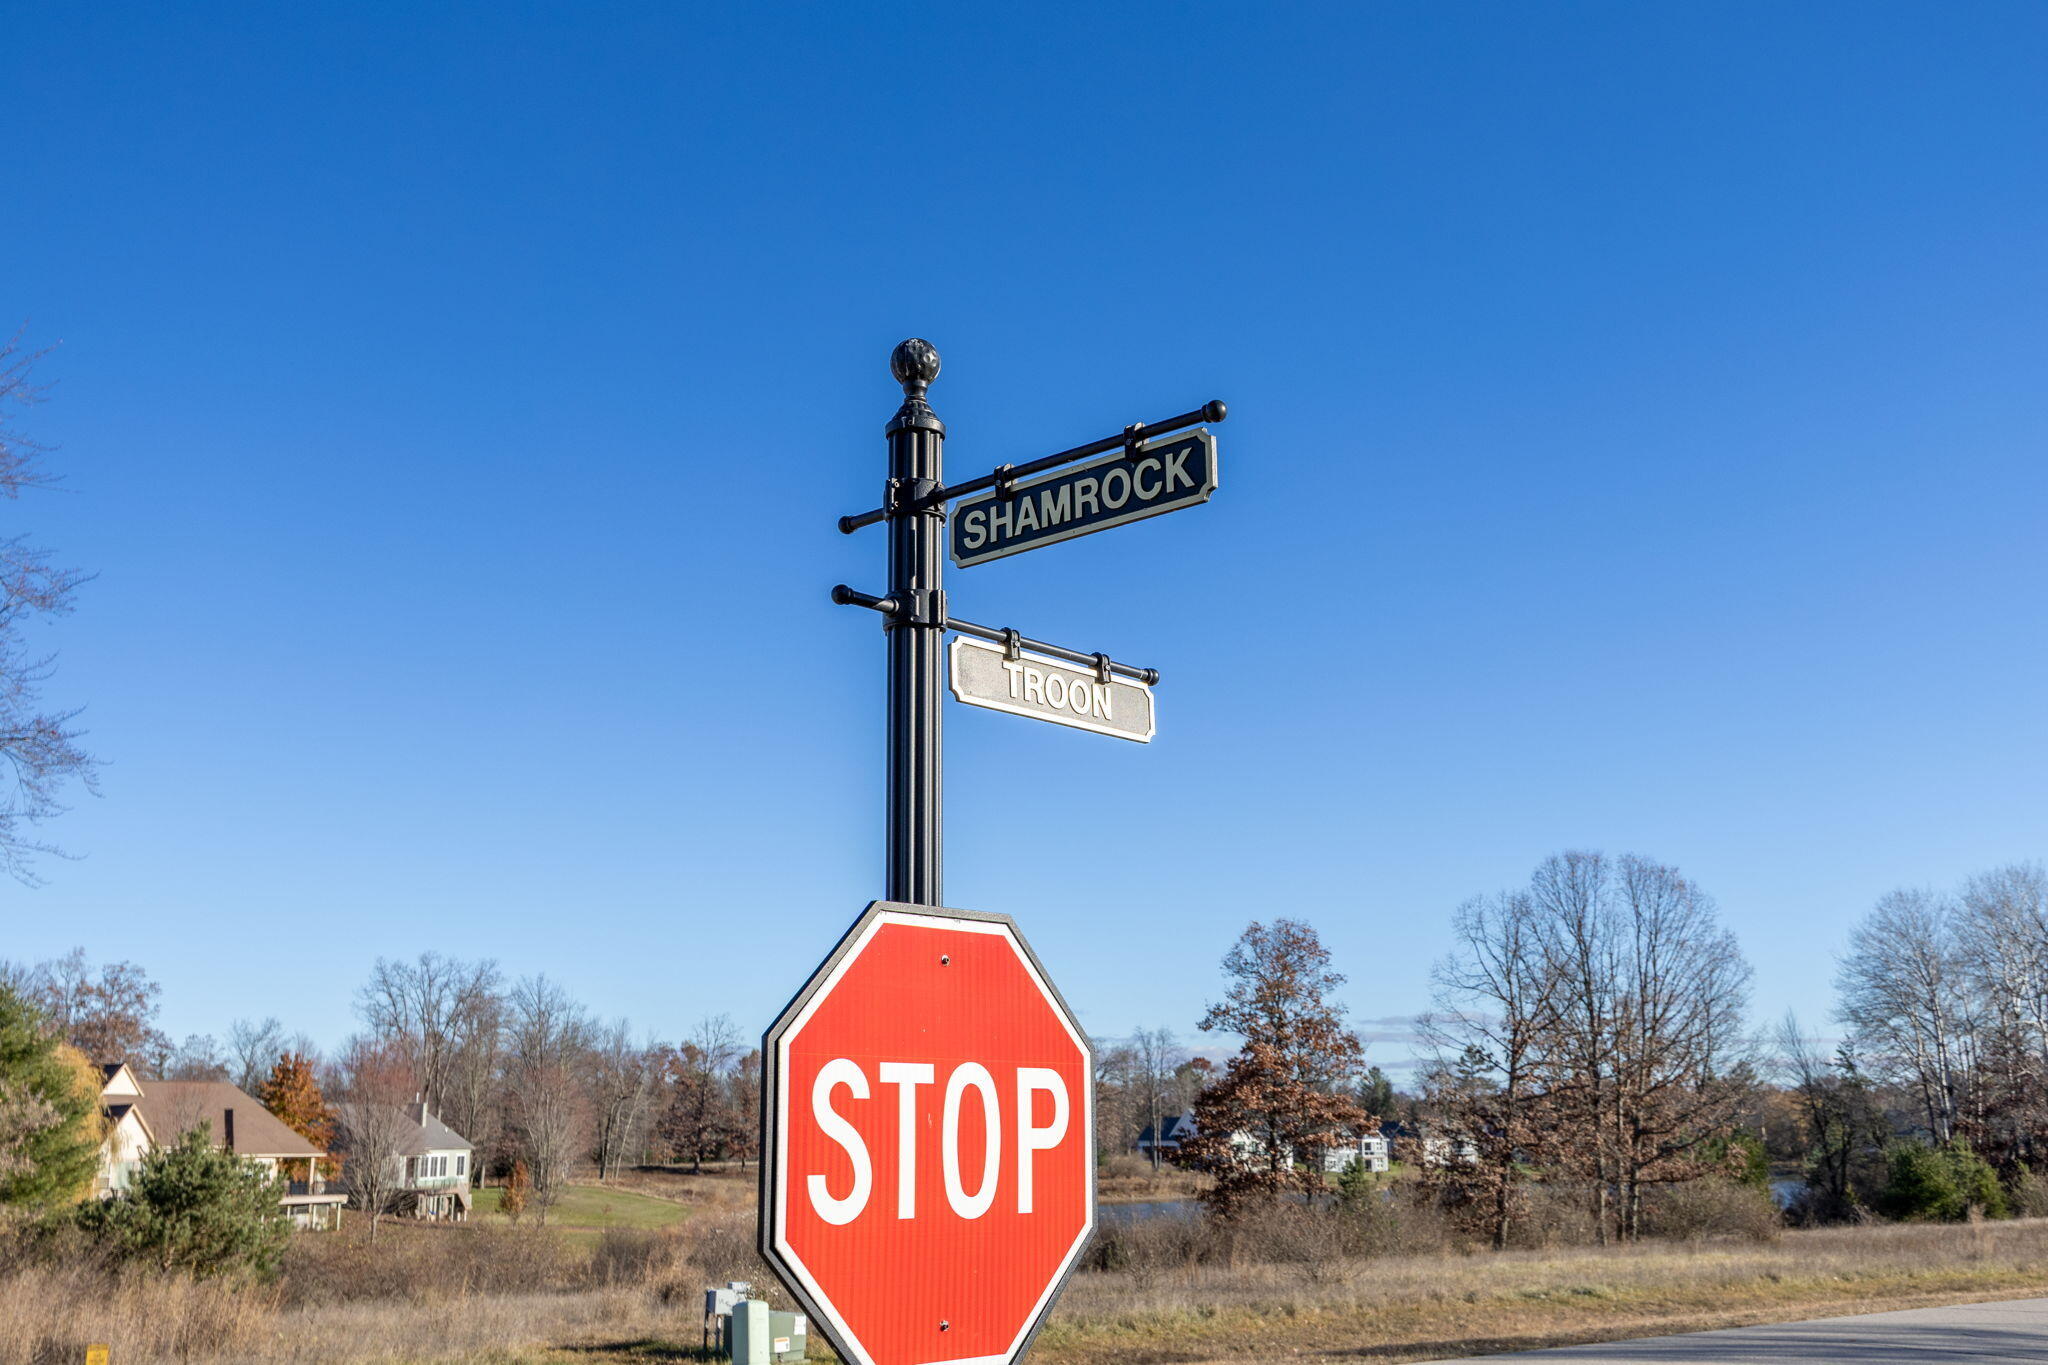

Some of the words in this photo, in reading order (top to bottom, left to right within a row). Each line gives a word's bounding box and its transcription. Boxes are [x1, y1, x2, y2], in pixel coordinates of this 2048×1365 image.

[963, 447, 1195, 549] SHAMROCK
[1002, 660, 1112, 720] TROON
[807, 1058, 1069, 1225] STOP
